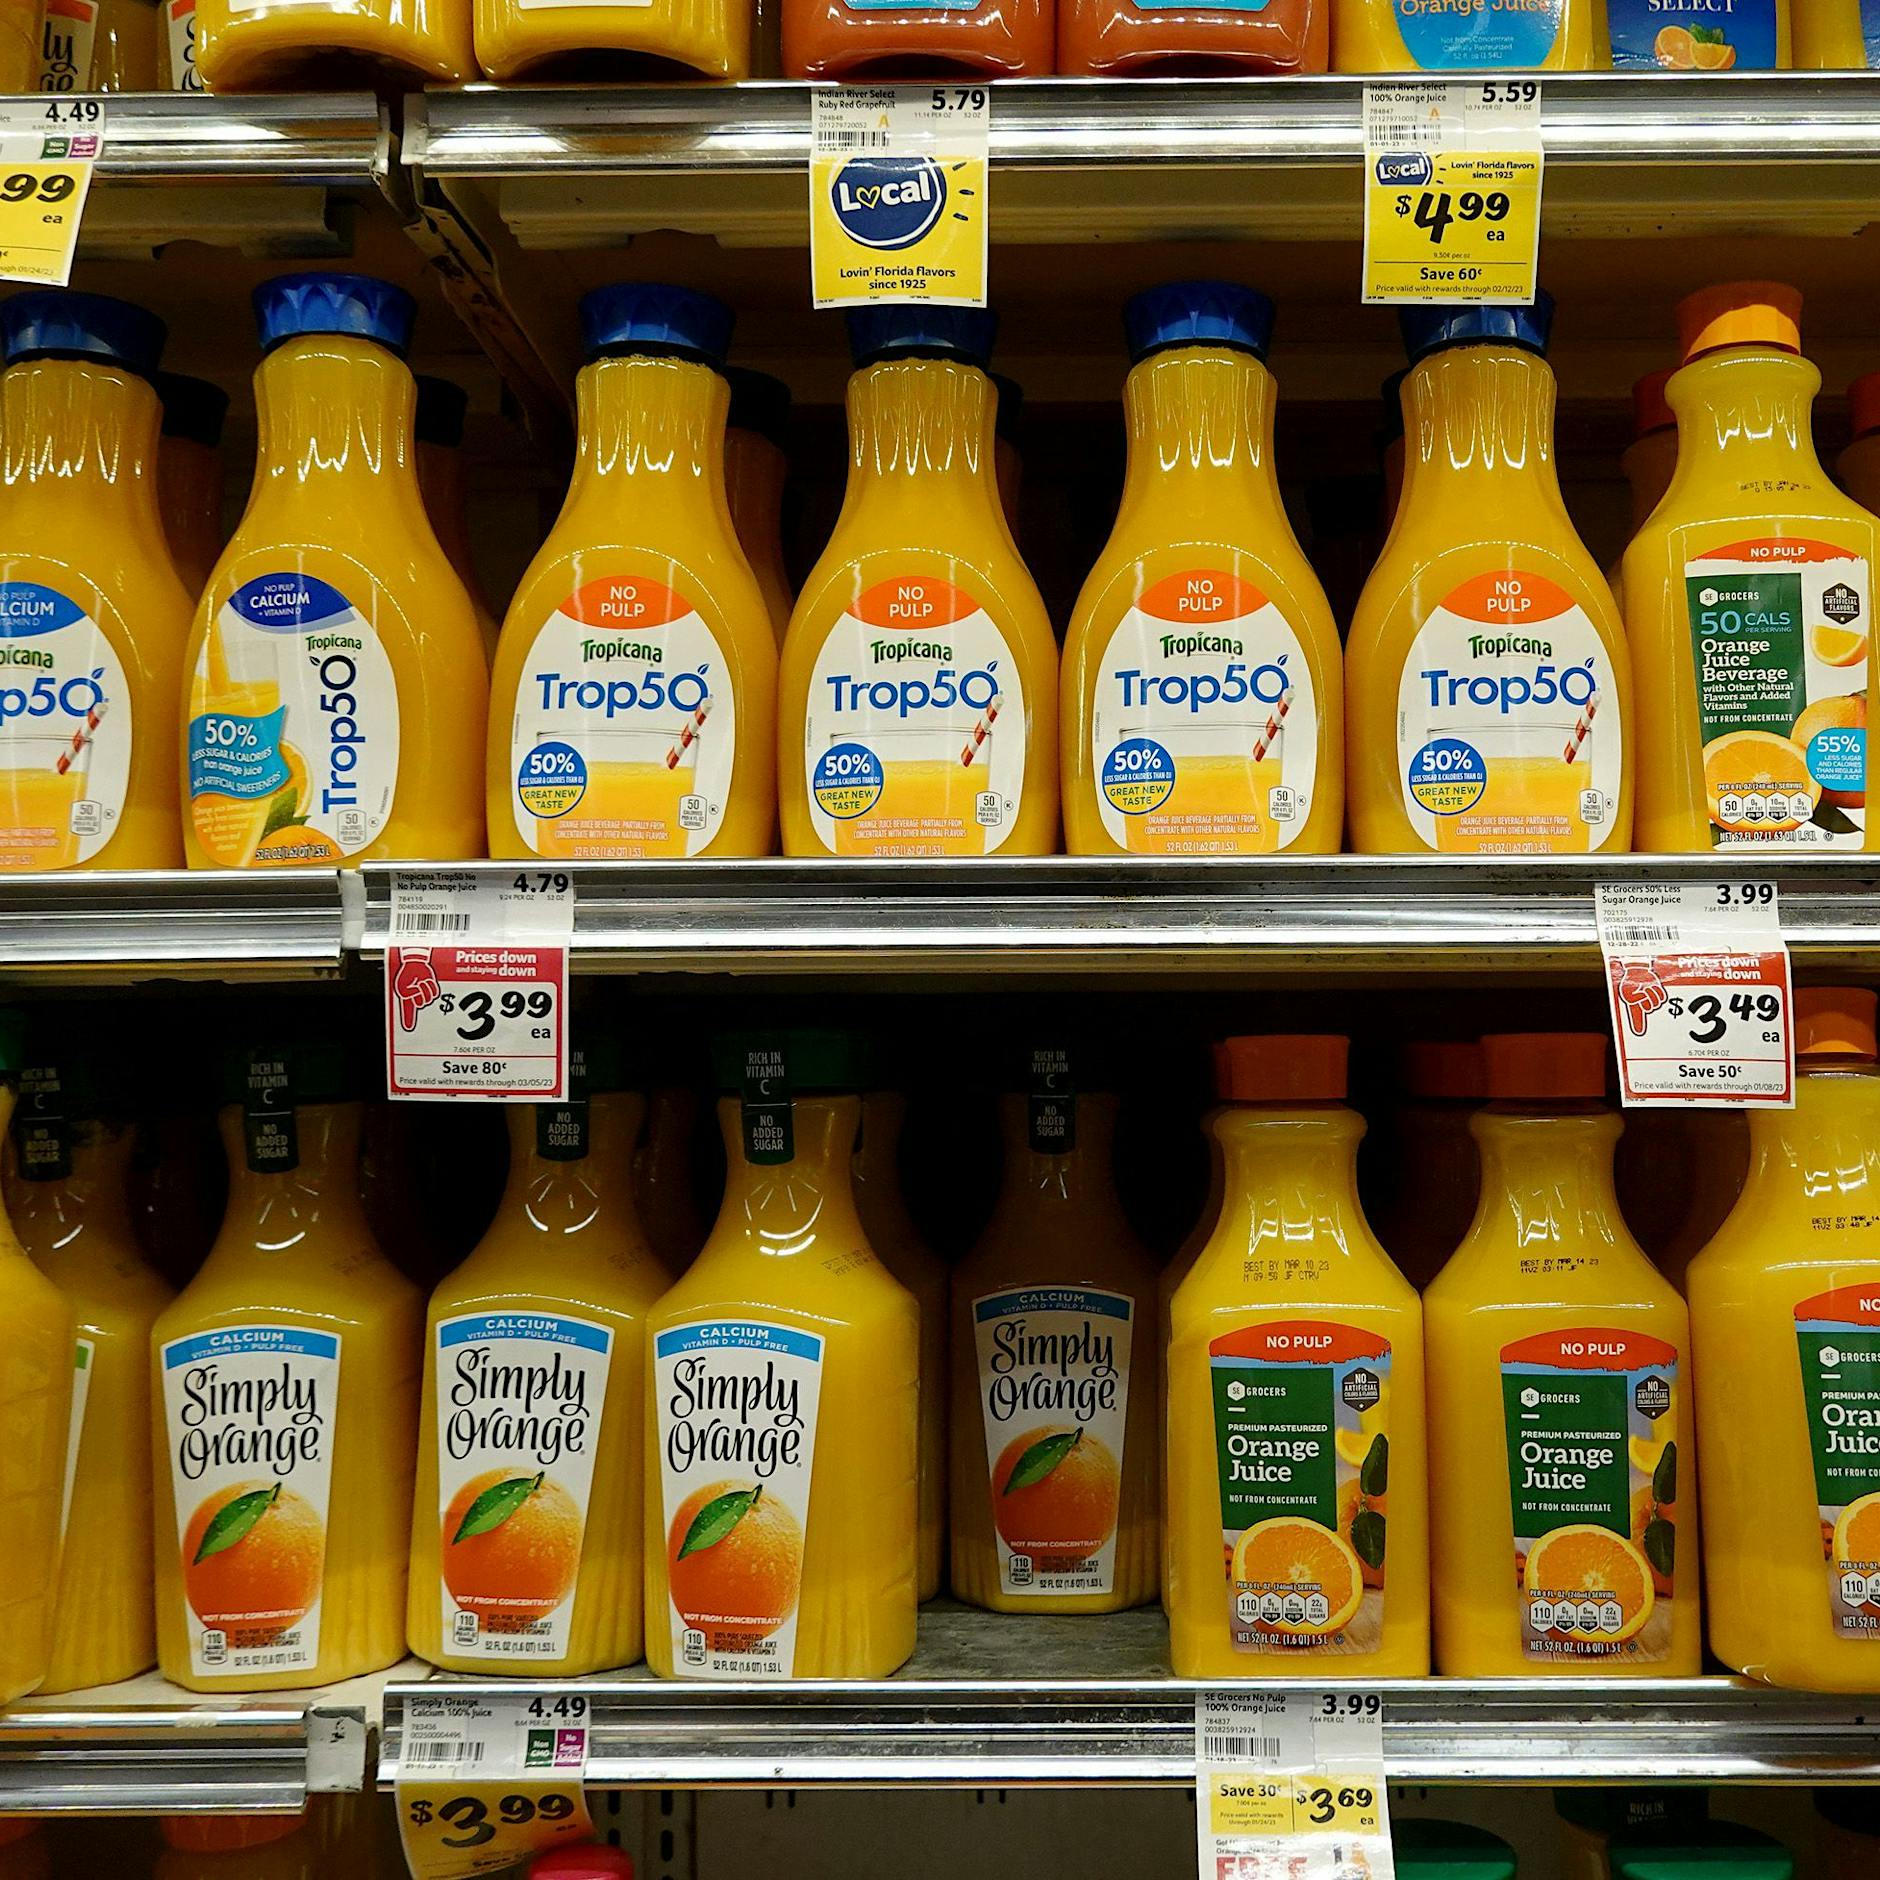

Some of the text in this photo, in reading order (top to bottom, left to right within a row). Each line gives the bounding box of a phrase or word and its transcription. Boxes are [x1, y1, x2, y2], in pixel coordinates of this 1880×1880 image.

[1400, 0, 1488, 16] Orange
[1370, 94, 1447, 104] 100% Orange Juice
[1482, 82, 1537, 102] 5.59
[818, 101, 837, 110] Ruby
[856, 101, 896, 110] Grapefruit
[932, 89, 985, 110] 5.79
[45, 102, 99, 122] 4.49
[1507, 162, 1535, 170] flavors
[42, 214, 63, 224] ea
[1486, 230, 1505, 241] ea
[875, 267, 913, 276] Florida
[917, 266, 956, 277] flavors
[1420, 267, 1455, 280] Save
[869, 280, 926, 289] since 1925
[1463, 286, 1491, 294] through
[1750, 546, 1806, 557] NO PULP
[610, 586, 637, 600] NO
[898, 586, 924, 600] NO
[1187, 580, 1214, 594] NO
[1496, 581, 1521, 595] NO
[250, 592, 310, 609] CALCIUM
[1719, 592, 1759, 601] GROCERS
[601, 604, 646, 617] PULP
[889, 603, 934, 618] PULP
[1179, 597, 1223, 611] PULP
[1487, 598, 1532, 613] PULP
[1700, 610, 1791, 635] 50 CALS
[305, 634, 362, 651] Tropicana
[1160, 632, 1243, 658] Tropicana
[1469, 633, 1552, 659] Tropicana
[1701, 638, 1770, 654] Orange
[581, 637, 662, 663] Tropicana
[871, 637, 952, 663] Tropicana
[1702, 653, 1750, 667] Juice
[1702, 668, 1788, 682] Beverage
[827, 670, 999, 718] Trop50
[1115, 664, 1289, 713] Trop50
[1421, 666, 1596, 713] Trop50
[1703, 682, 1793, 692] with Other Natural
[536, 671, 709, 718] Trop50
[1703, 693, 1738, 702] Flavors
[1703, 702, 1748, 711] Vitamins
[205, 719, 257, 747] 50%
[320, 655, 366, 814] Trop50
[1817, 736, 1861, 752] 55%
[530, 753, 575, 774] 50%
[825, 753, 871, 776] 50%
[1114, 749, 1162, 772] 50%
[1422, 749, 1473, 772] 50%
[1276, 791, 1288, 801] 50
[1418, 786, 1476, 797] GREAT NEW
[1432, 797, 1463, 806] TASTE
[1725, 801, 1737, 811] 50
[513, 873, 569, 893] 4.79
[1602, 885, 1681, 893] SE Grocers 50% Less
[1602, 896, 1681, 905] Sugar Orange Juice
[1716, 884, 1773, 905] 3.99
[456, 951, 536, 963] Prices down
[1721, 957, 1760, 967] down
[498, 964, 536, 976] down
[1724, 968, 1761, 980] down
[531, 1028, 551, 1039] ea
[1762, 1032, 1780, 1043] ea
[442, 1061, 478, 1074] Save
[1678, 1065, 1715, 1078] Save
[760, 1115, 774, 1126] NO
[752, 1127, 784, 1138] ADDED
[753, 1138, 784, 1150] SUGAR
[1244, 1261, 1330, 1272] BEST BY MAR 10 23
[485, 1319, 558, 1331] CALCIUM
[210, 1332, 284, 1346] CALCIUM
[700, 1327, 769, 1339] CALCIUM
[991, 1319, 1119, 1378] Simply
[1267, 1336, 1333, 1348] NO PULP
[1561, 1343, 1626, 1355] NO PULP
[451, 1347, 590, 1414] Simply
[181, 1363, 323, 1426] Simply
[671, 1357, 804, 1427] Simply
[989, 1372, 1116, 1421] Orange
[1247, 1387, 1286, 1396] GROCERS
[1541, 1393, 1581, 1403] GROCERS
[1228, 1424, 1328, 1432] PREMIUM PASTEURIZED
[447, 1407, 585, 1464] Orange
[180, 1423, 319, 1480] Orange
[668, 1418, 800, 1477] Orange
[1228, 1435, 1319, 1462] Orange
[1521, 1442, 1613, 1469] Orange
[1229, 1459, 1292, 1482] Juice
[1522, 1467, 1586, 1489] Juice
[1229, 1494, 1317, 1504] NOT FROM CONCENTRATE
[1534, 1607, 1550, 1618] 110
[1204, 1693, 1215, 1701] SE
[1217, 1693, 1251, 1701] Grocers
[1267, 1694, 1286, 1703] Pulp
[1322, 1694, 1380, 1715] 3.99
[528, 1697, 586, 1718] 4.49
[1205, 1704, 1286, 1714] 100% Orange Juice
[1220, 1784, 1255, 1797] Save
[1360, 1817, 1374, 1825] ea
